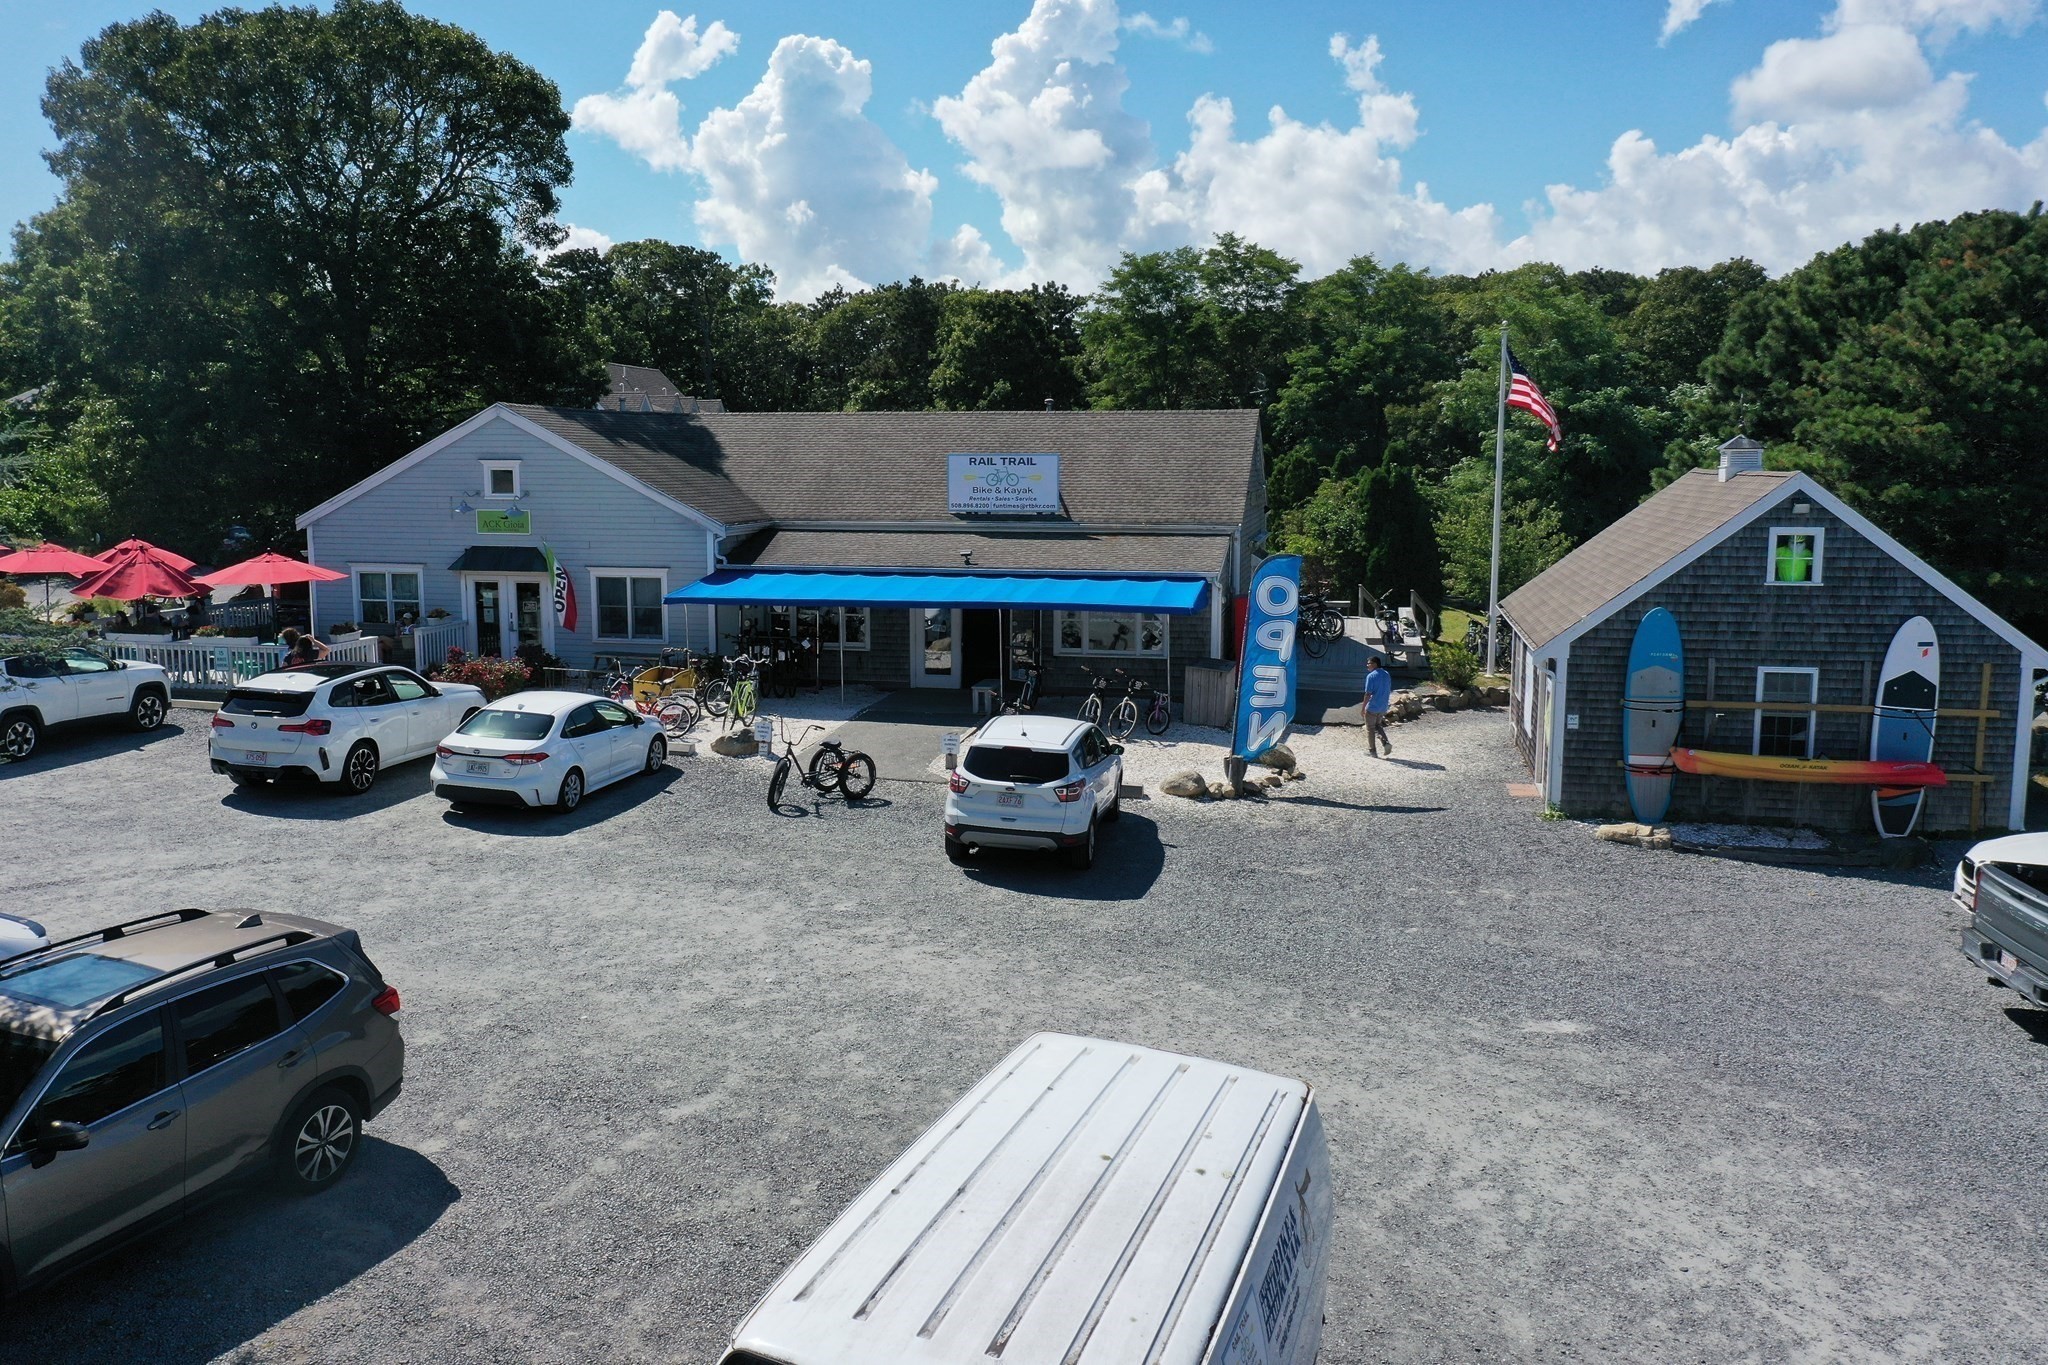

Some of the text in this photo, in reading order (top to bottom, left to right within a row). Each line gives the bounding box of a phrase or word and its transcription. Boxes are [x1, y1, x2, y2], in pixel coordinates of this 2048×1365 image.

[969, 457, 1037, 466] RAIL TRAIL
[972, 486, 992, 494] Bike
[1004, 486, 1034, 496] Kayak
[482, 520, 525, 529] ACK Gioia
[554, 566, 567, 613] OPEN
[1247, 575, 1299, 752] OPEN
[1231, 1310, 1249, 1353] RAIL TRAIL
